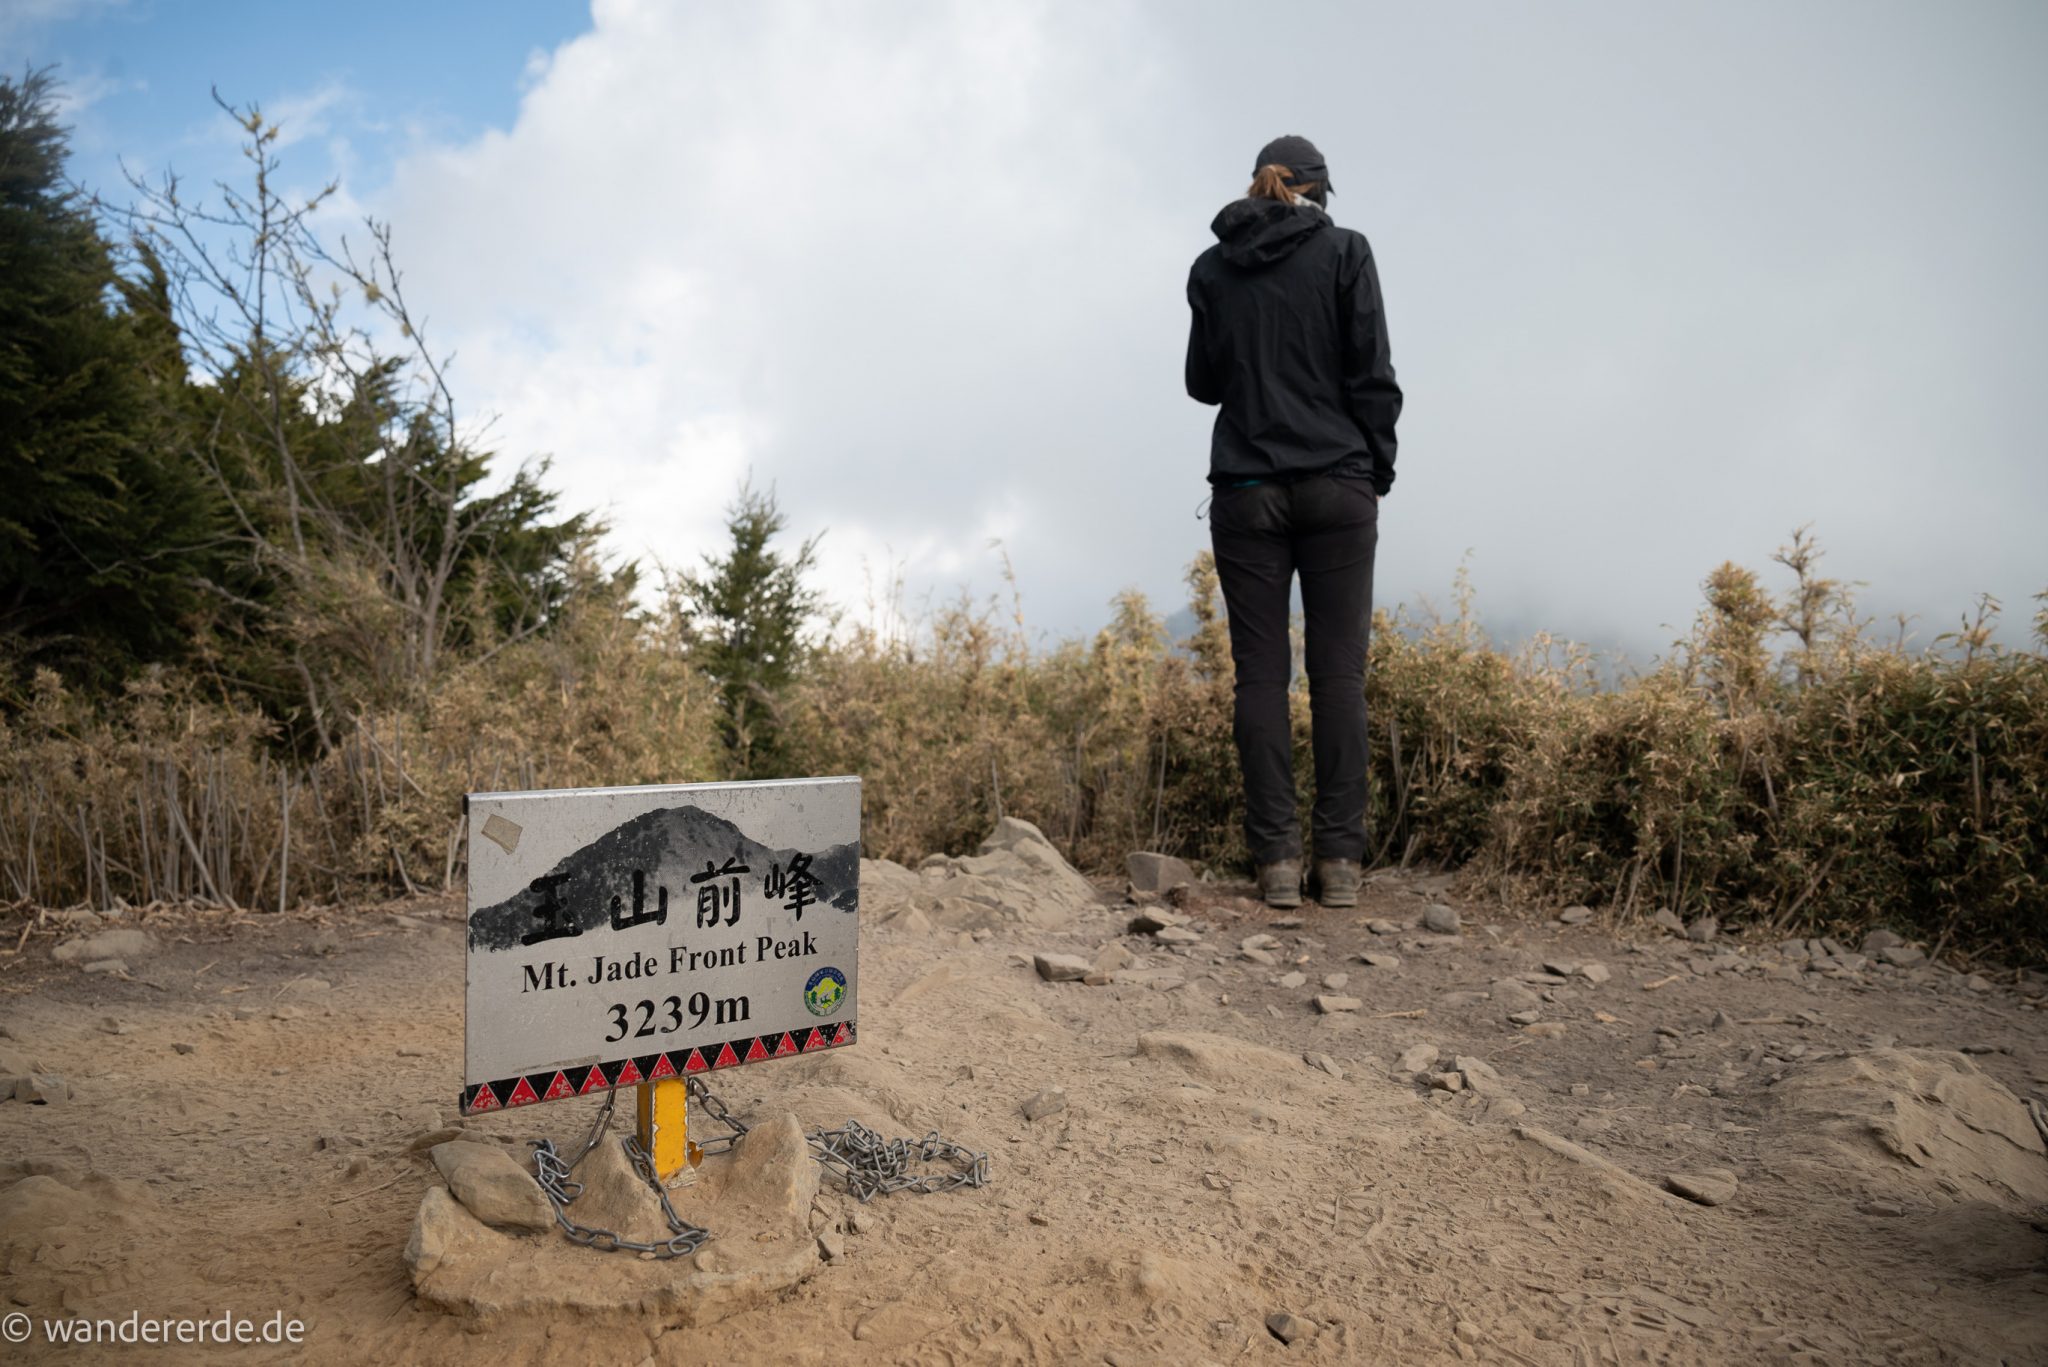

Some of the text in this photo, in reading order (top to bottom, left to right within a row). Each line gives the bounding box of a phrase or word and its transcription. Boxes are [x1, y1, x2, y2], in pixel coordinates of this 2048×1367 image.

[521, 852, 824, 946] 玉山前峰
[523, 932, 818, 993] Mt. Jade Front Peak
[605, 991, 751, 1043] 3239m
